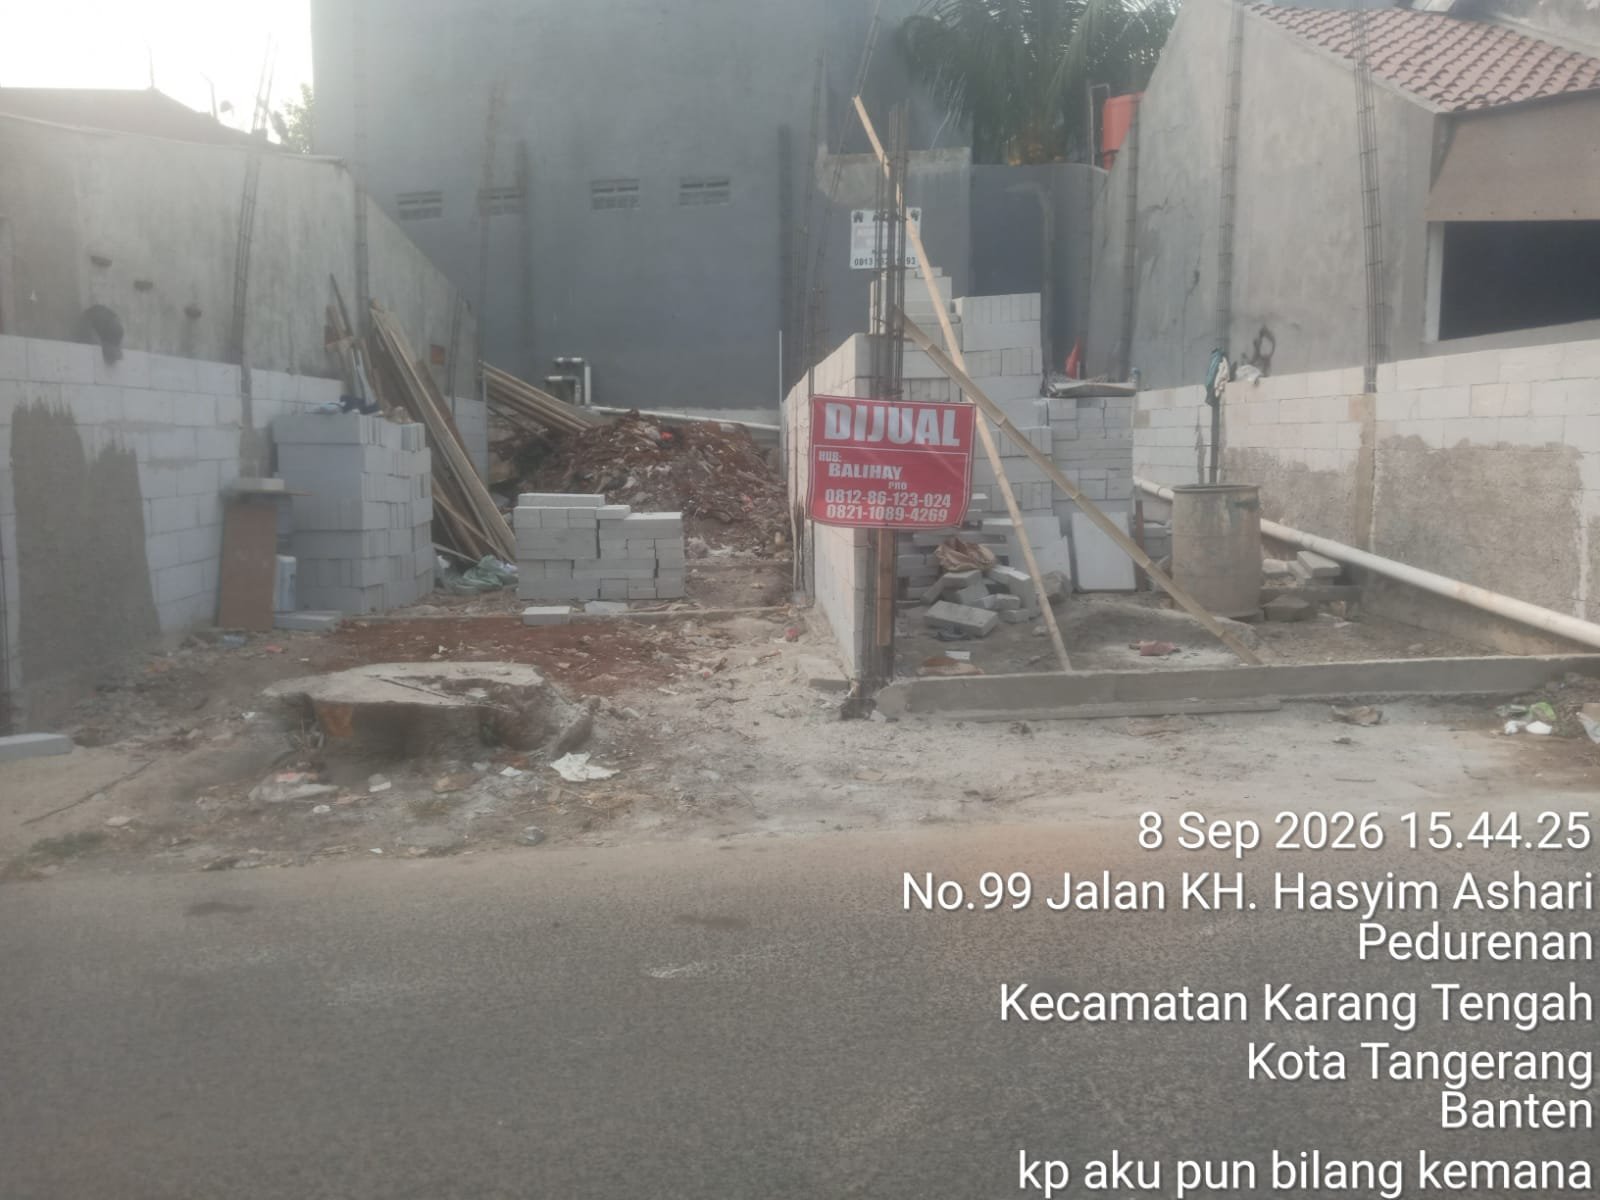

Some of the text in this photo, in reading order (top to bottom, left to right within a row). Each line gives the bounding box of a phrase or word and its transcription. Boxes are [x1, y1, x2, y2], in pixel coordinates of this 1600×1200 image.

[824, 402, 960, 447] DIJUAL
[828, 463, 903, 480] BALIHAY
[825, 489, 951, 508] 0812-86-123-024
[826, 504, 948, 522] 0821-1089-4269
